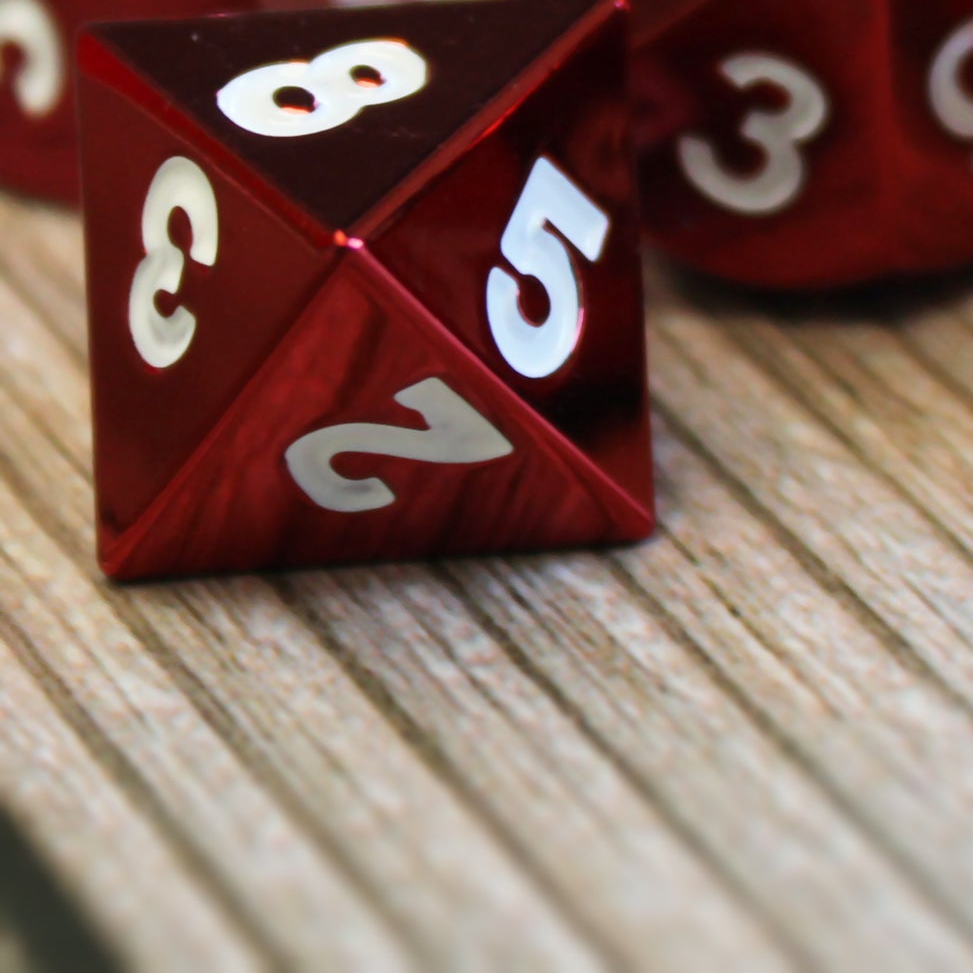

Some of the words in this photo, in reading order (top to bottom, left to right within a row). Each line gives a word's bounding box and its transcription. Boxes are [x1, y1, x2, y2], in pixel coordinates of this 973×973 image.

[215, 38, 428, 139] 8
[680, 53, 829, 215] 3
[127, 155, 220, 370] 3
[485, 156, 610, 380] 5
[284, 375, 515, 514] 2
